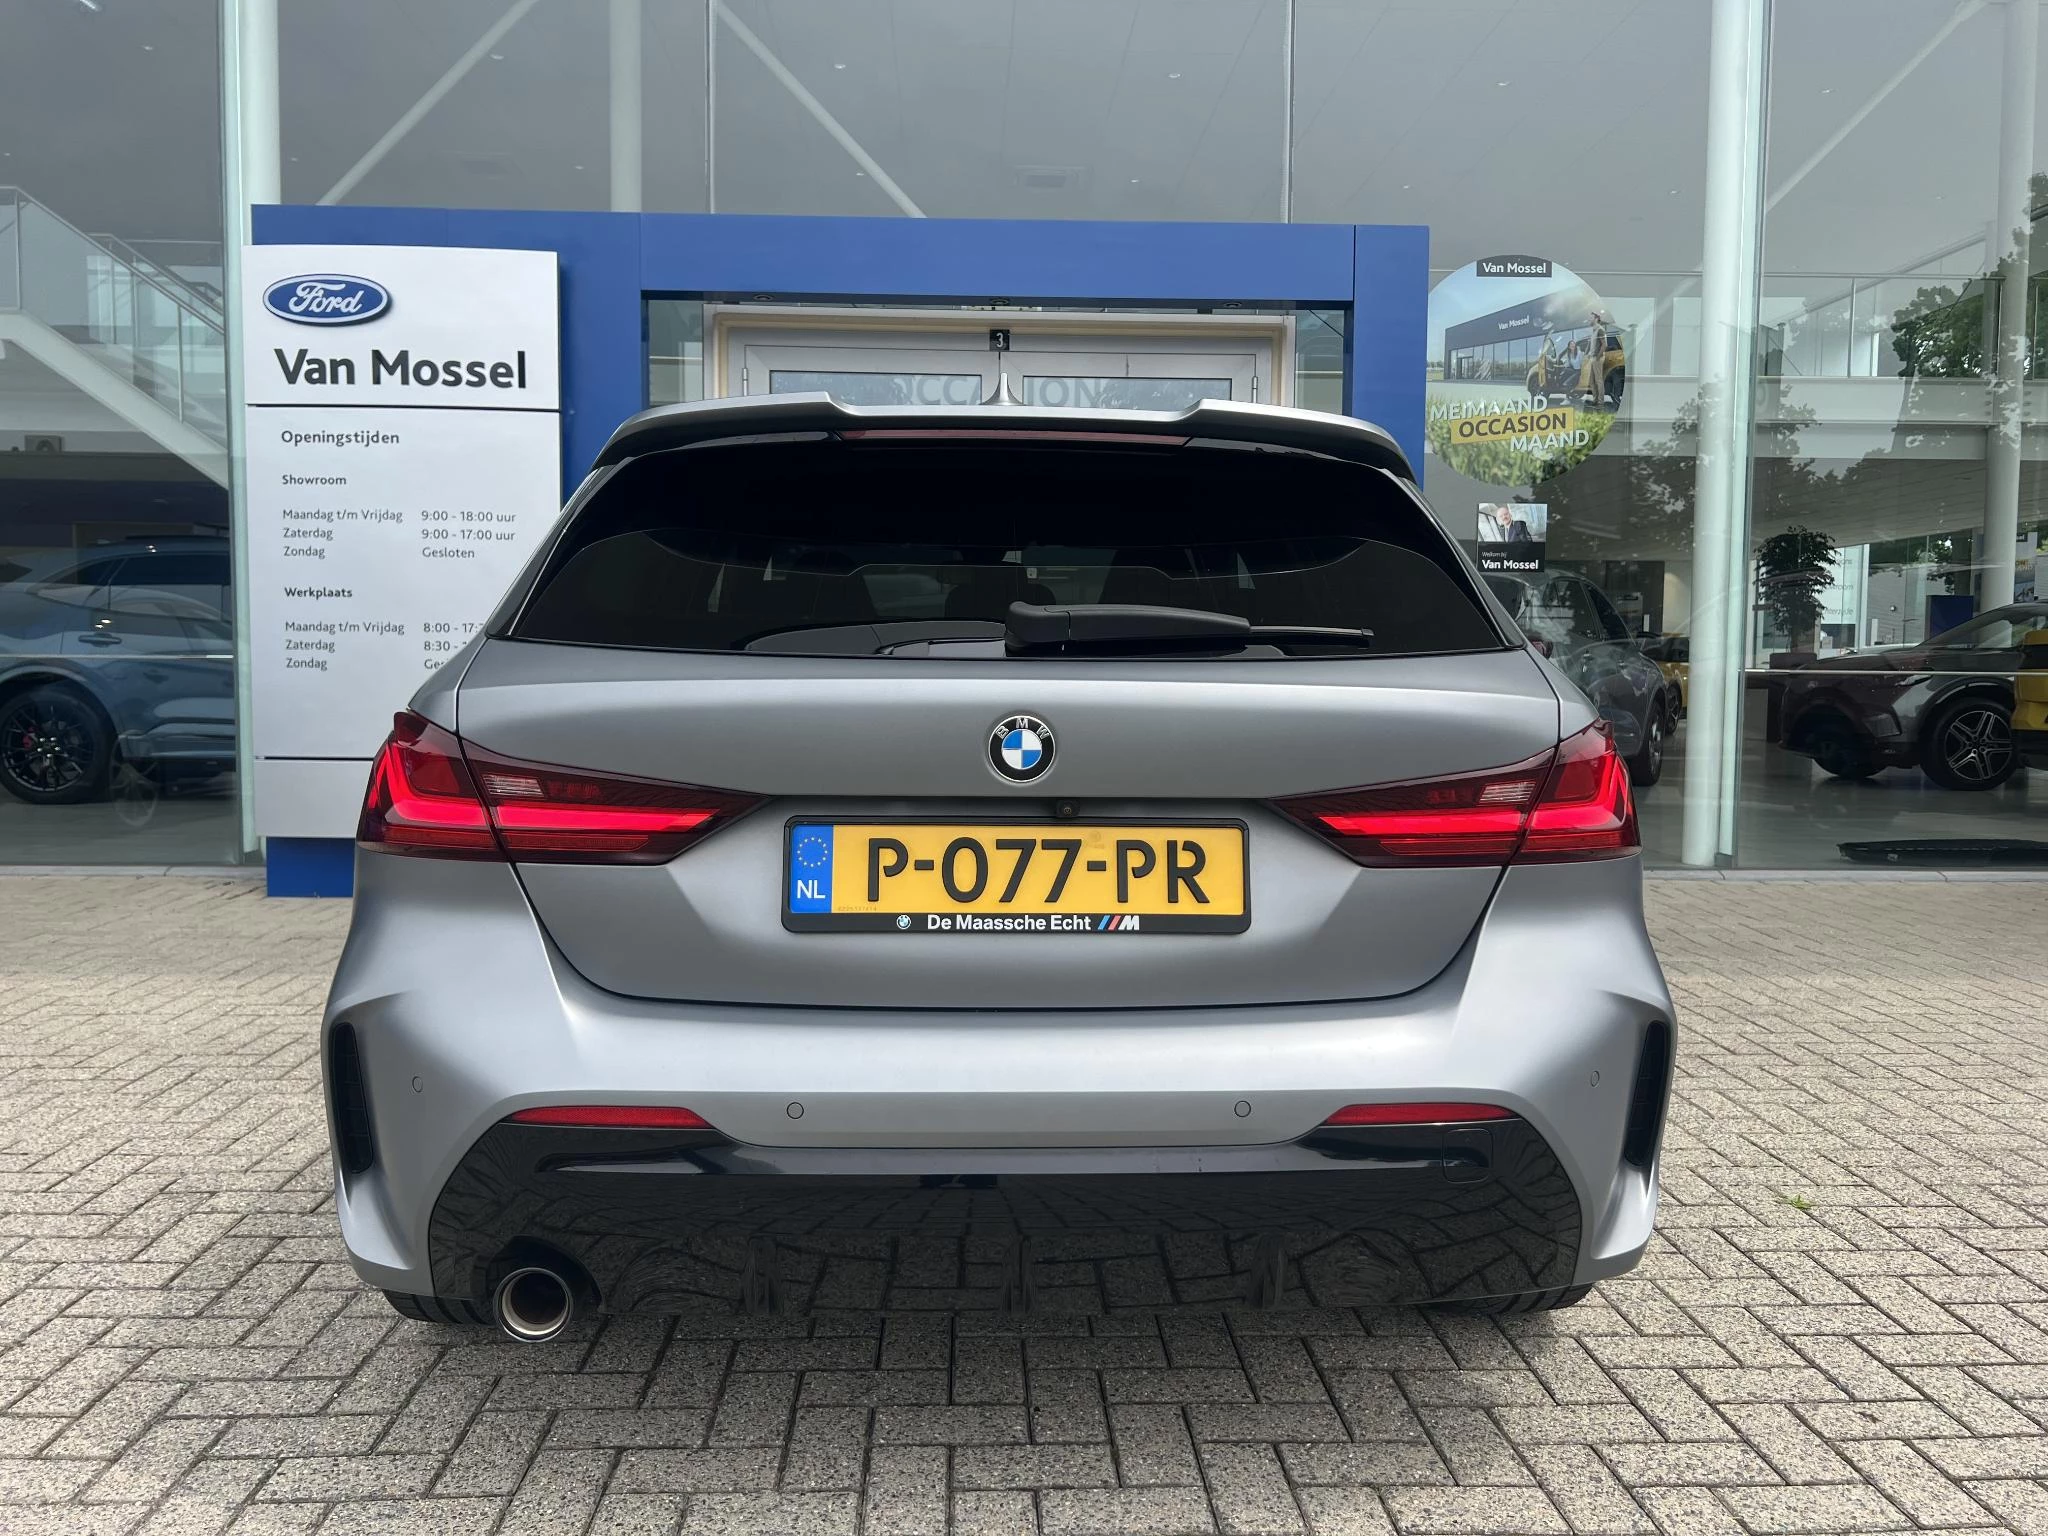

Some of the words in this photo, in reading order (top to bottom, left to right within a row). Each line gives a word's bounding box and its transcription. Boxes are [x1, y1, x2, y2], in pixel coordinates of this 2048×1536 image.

[1482, 262, 1504, 273] Van
[1507, 262, 1547, 274] Mossel
[288, 281, 365, 313] Ford
[1498, 320, 1509, 330] Van
[1509, 315, 1530, 328] Mossel
[996, 332, 1004, 348] 3
[274, 348, 356, 385] Van
[371, 349, 527, 389] Mossel
[1431, 396, 1548, 421] MEIMAAND
[1458, 413, 1567, 438] OCCASION
[281, 429, 400, 448] Openingstijden
[1510, 429, 1589, 453] MAAND
[282, 474, 347, 486] Showroom
[282, 509, 335, 523] Maandag
[336, 509, 358, 521] t/m
[361, 509, 403, 524] Vrijdag
[421, 510, 449, 522] 9:00
[460, 510, 493, 522] 18:00
[496, 513, 517, 523] uur
[283, 527, 334, 541] Zaterdag
[421, 529, 449, 540] 9:00
[460, 529, 493, 541] 17:00
[495, 532, 516, 541] uur
[283, 546, 326, 560] Zondag
[422, 546, 475, 559] Gesloten
[1482, 560, 1500, 569] Van
[1504, 560, 1538, 570] Mossel
[284, 587, 353, 600] Werkplaats
[285, 621, 336, 635] Maandag
[338, 621, 360, 633] t/m
[363, 621, 405, 636] Vrijdag
[423, 622, 451, 634] 8:00
[285, 640, 336, 653] Zaterdag
[424, 641, 451, 652] 8:30
[286, 658, 328, 672] Zondag
[867, 836, 1211, 904] P-077-PR
[796, 879, 826, 899] NL
[927, 914, 952, 930] De
[956, 914, 1047, 930] Maassche
[1050, 914, 1091, 930] Echt
